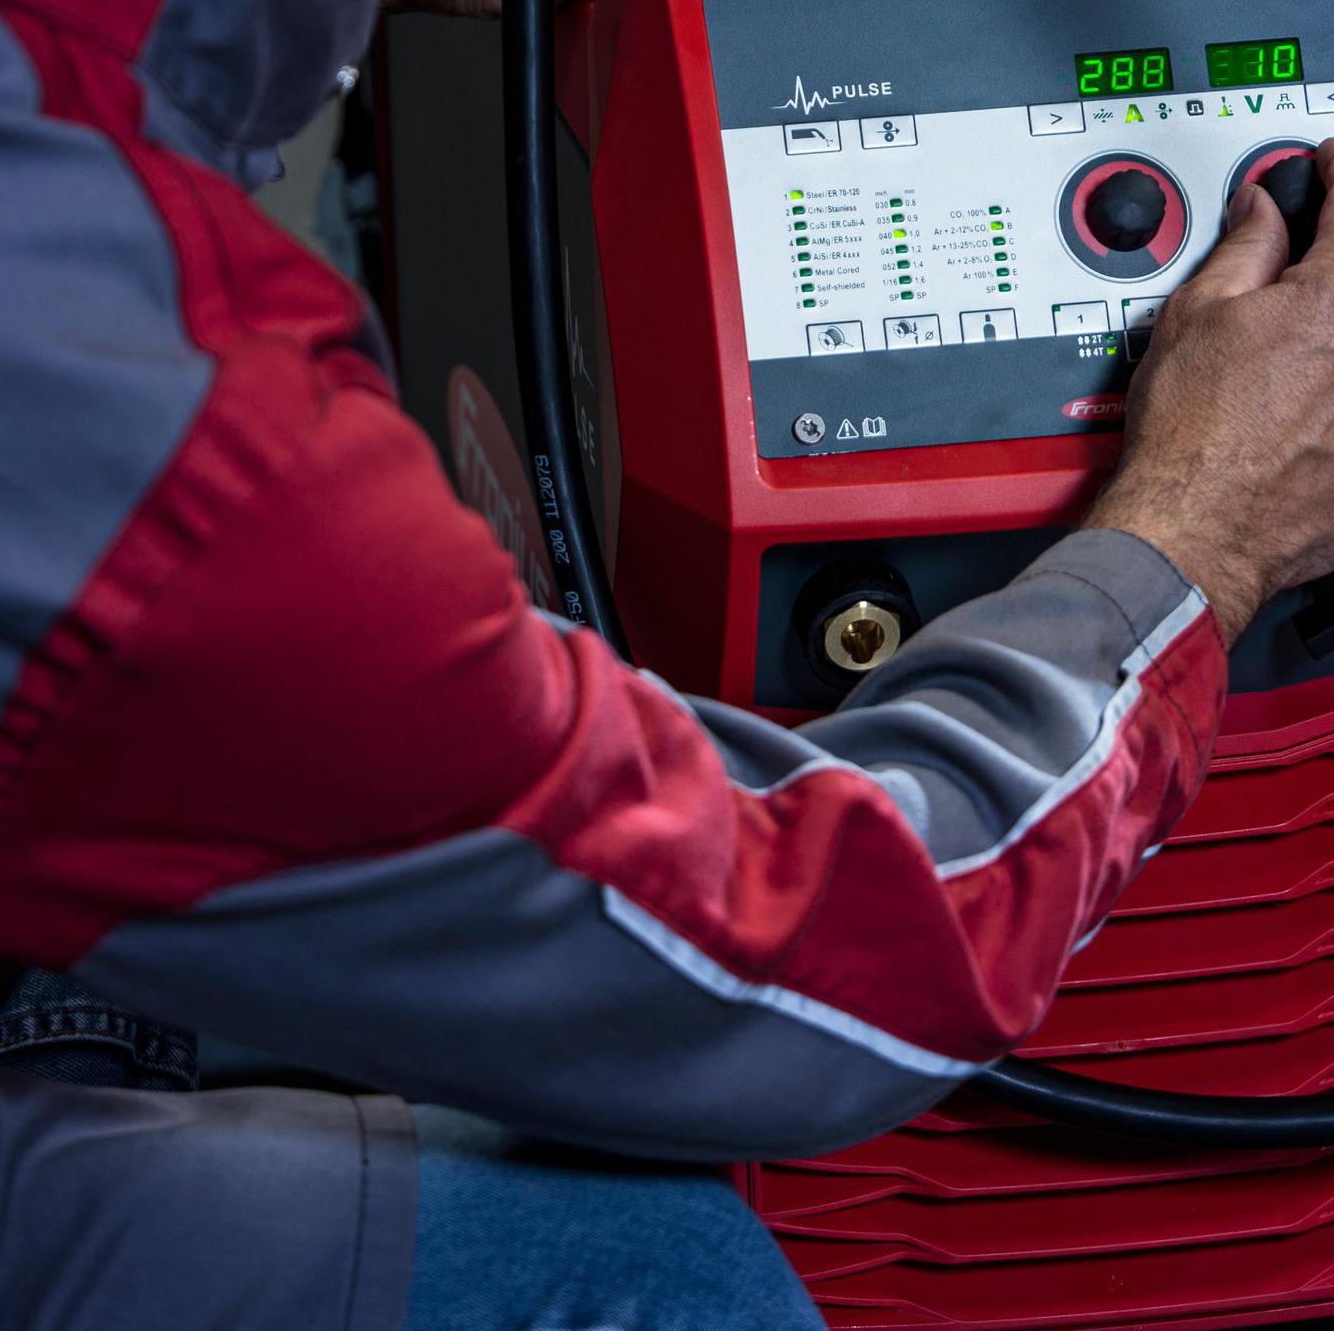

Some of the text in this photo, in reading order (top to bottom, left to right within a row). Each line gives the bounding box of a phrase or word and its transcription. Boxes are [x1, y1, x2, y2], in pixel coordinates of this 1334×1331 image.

[1080, 56, 1165, 92] 288
[832, 82, 892, 99] PULSE
[1244, 94, 1264, 114] V
[1125, 104, 1144, 124] A
[837, 266, 860, 275] Cored
[819, 299, 829, 307] SP
[889, 291, 927, 302] SP SP
[1147, 308, 1155, 318] 2
[1092, 335, 1103, 344] 2T
[1093, 347, 1104, 357] 4T
[1070, 399, 1125, 416] Froni
[549, 530, 570, 564] 200
